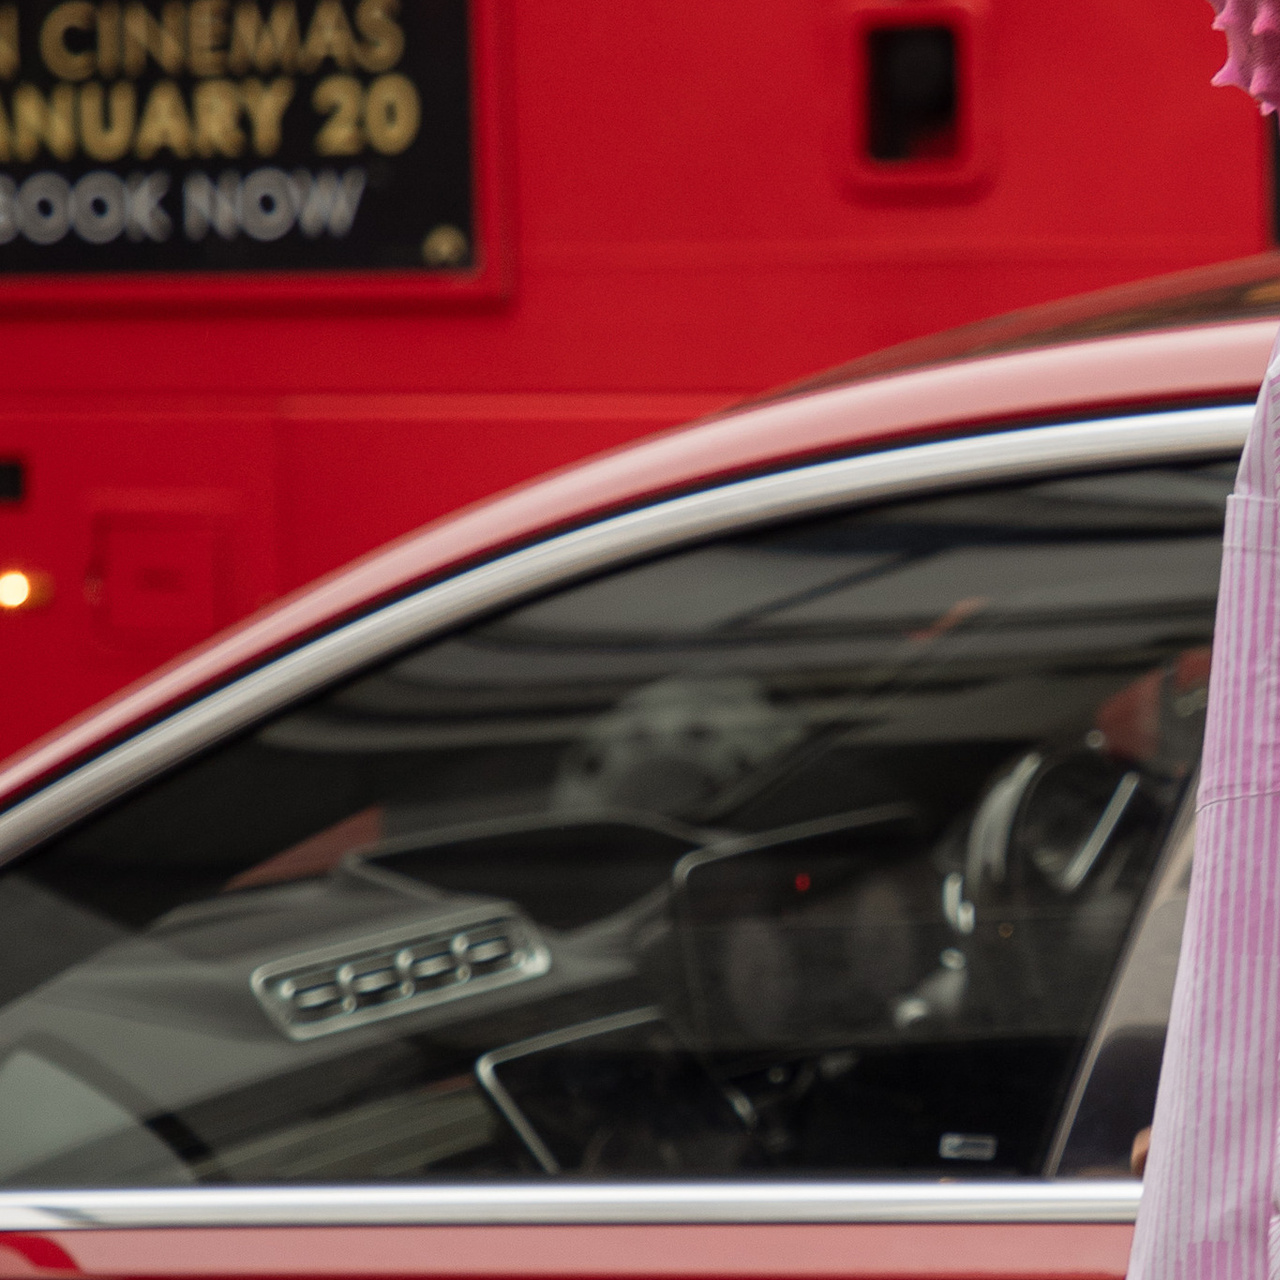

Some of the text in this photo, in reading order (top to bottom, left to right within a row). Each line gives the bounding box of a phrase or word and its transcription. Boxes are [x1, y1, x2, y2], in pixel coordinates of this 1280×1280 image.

[0, 73, 421, 161] NUARY 20
[183, 166, 367, 243] NOW
